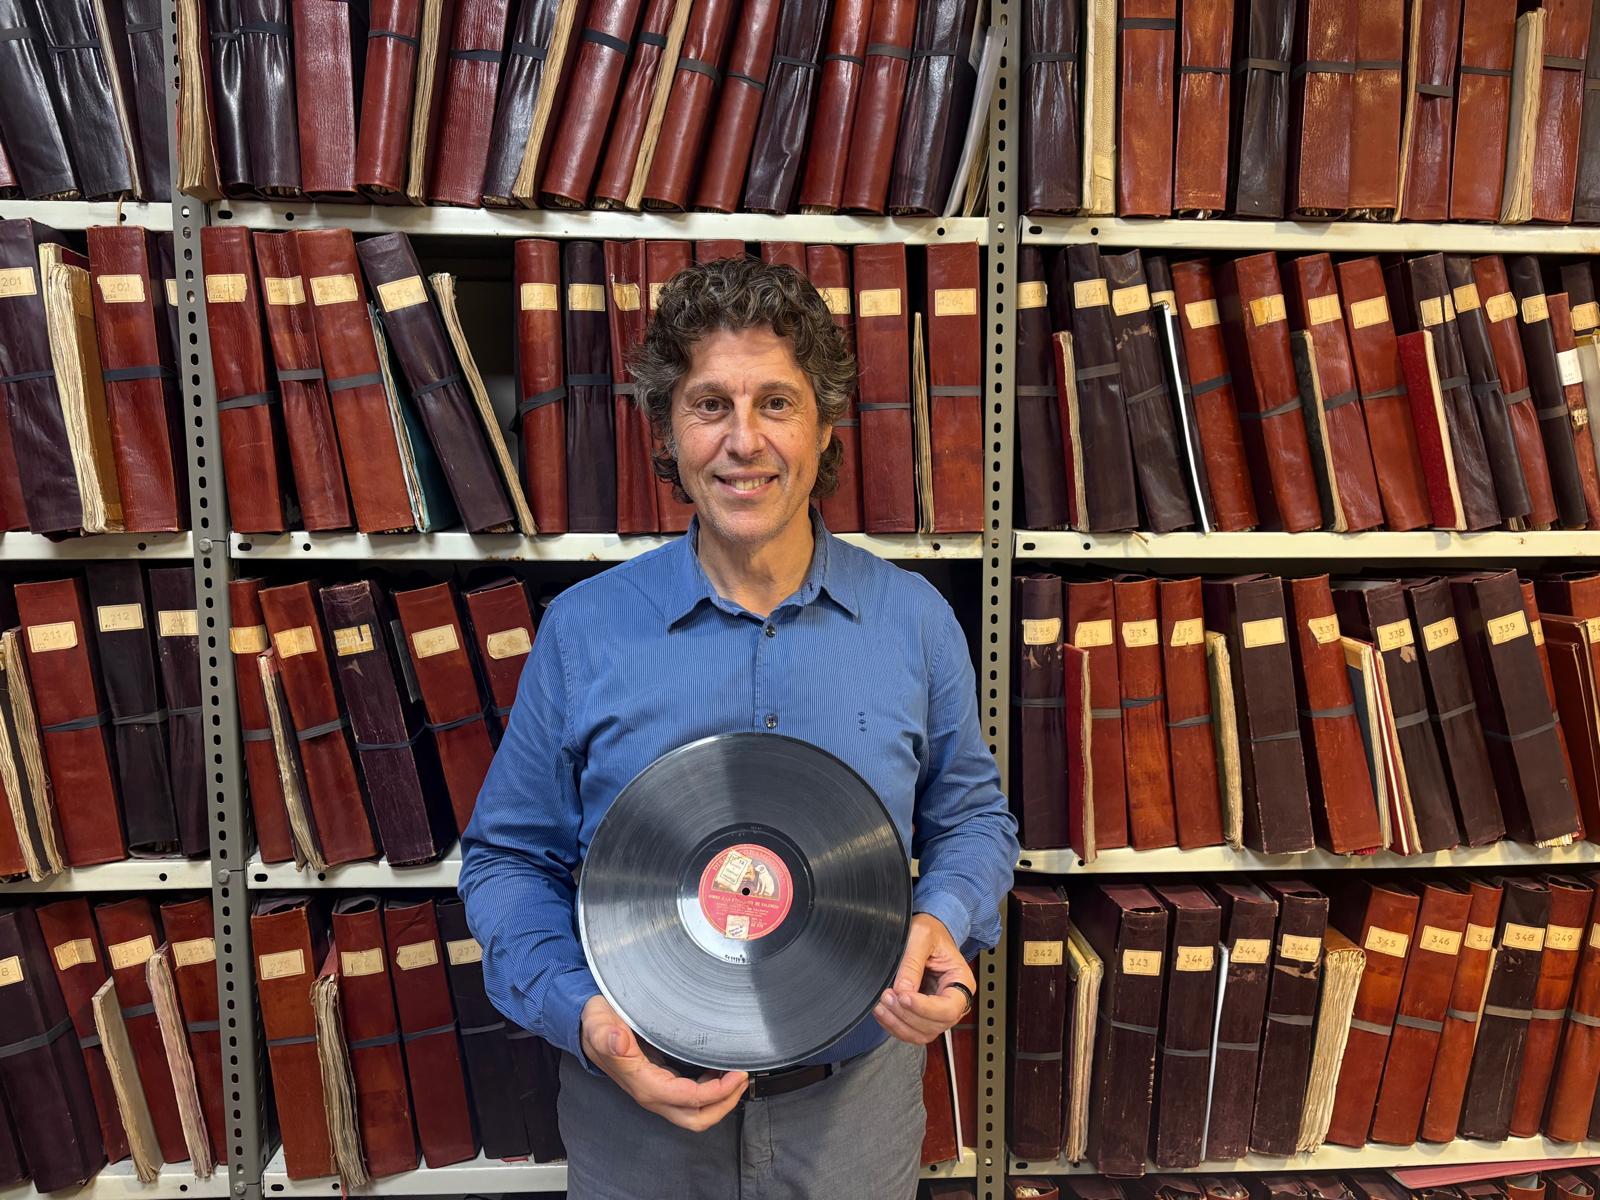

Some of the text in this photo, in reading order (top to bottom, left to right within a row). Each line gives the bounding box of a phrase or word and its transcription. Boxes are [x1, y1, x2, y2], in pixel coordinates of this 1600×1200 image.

[1, 276, 22, 287] 201
[1129, 628, 1148, 637] 335
[1318, 624, 1335, 635] 337
[1498, 622, 1516, 634] 339
[1388, 628, 1406, 640] 338
[1432, 627, 1449, 640] 339
[1376, 936, 1396, 948] 345
[1431, 935, 1450, 946] 346
[1514, 932, 1535, 942] 348
[1238, 945, 1257, 955] 344
[1290, 943, 1309, 952] 344
[1033, 948, 1052, 958] 342
[1129, 958, 1149, 968] 343
[1185, 954, 1203, 963] 344
